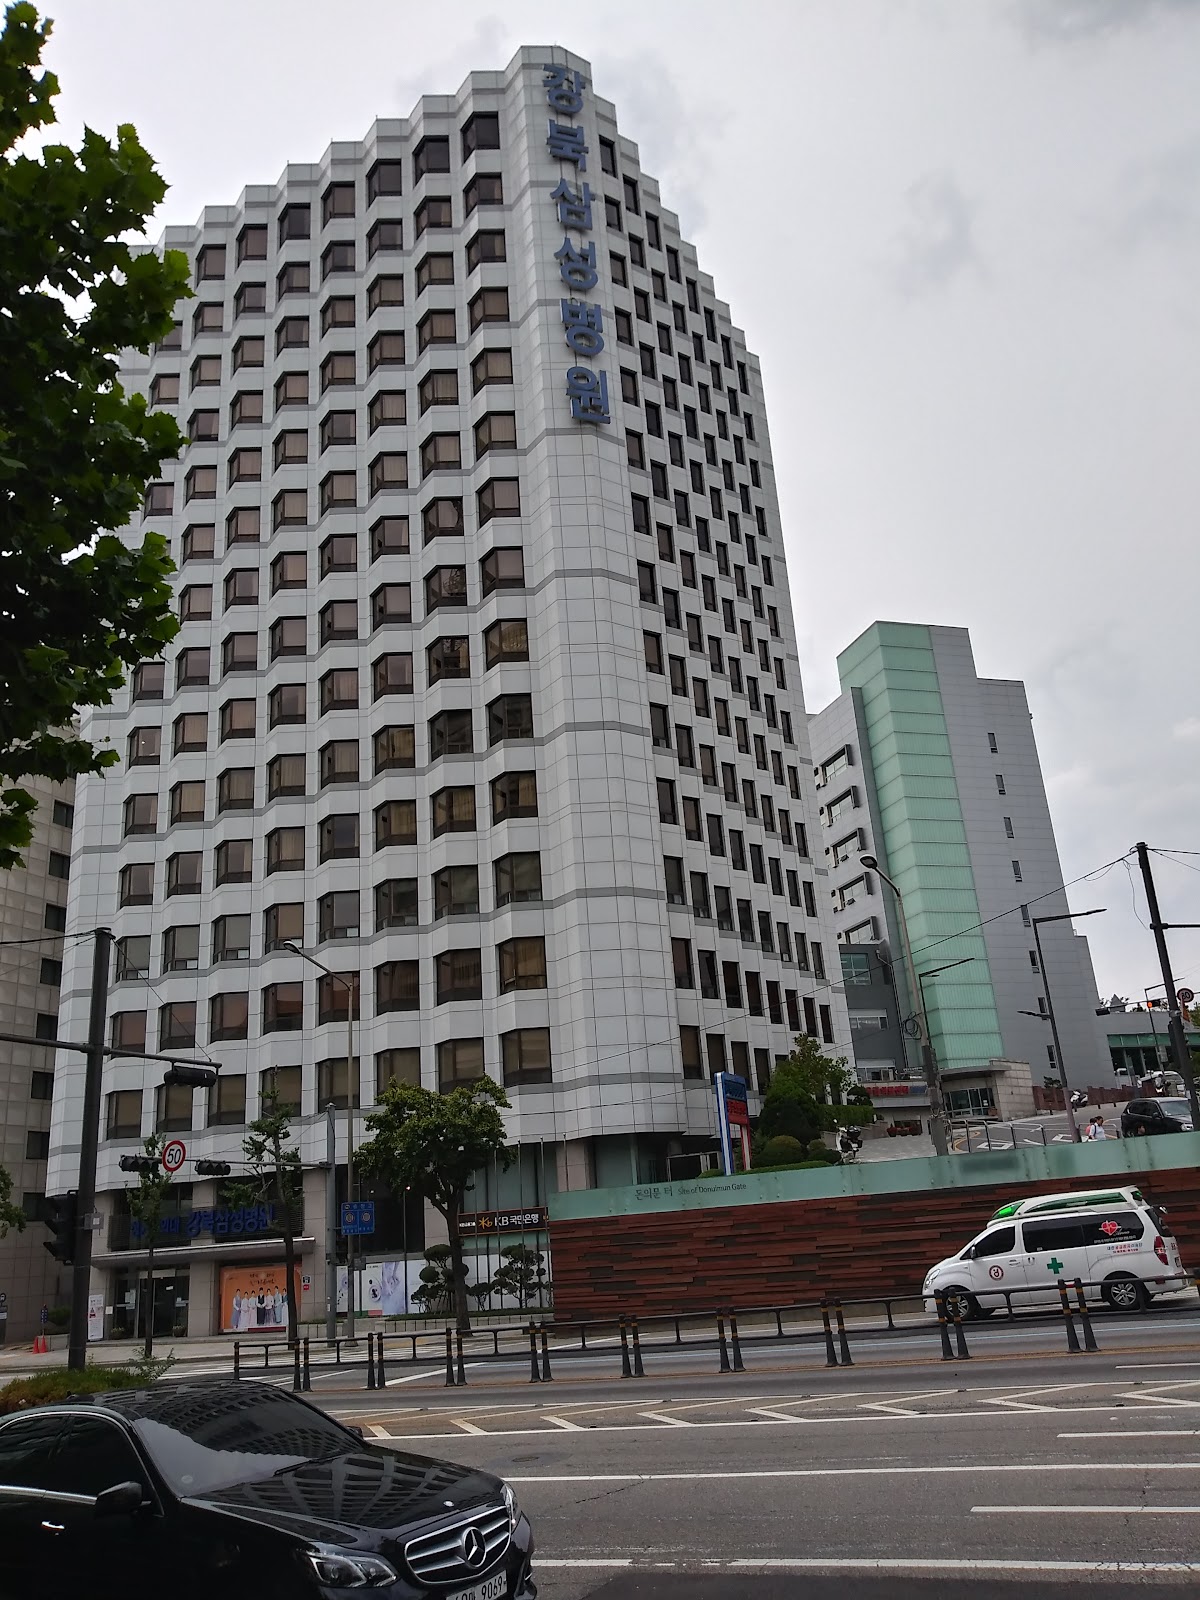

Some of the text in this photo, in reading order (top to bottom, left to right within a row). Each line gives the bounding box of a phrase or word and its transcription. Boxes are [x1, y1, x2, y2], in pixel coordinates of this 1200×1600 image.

[542, 63, 611, 425] 강북삼성병원
[166, 1148, 182, 1165] 50
[635, 1185, 673, 1200] 돈의문 터
[677, 1186, 690, 1196] Site
[731, 1183, 747, 1191] Gate
[186, 1204, 275, 1239] 강북삼성병원
[494, 1213, 539, 1227] KB국민은행
[481, 1575, 503, 1600] 9069
